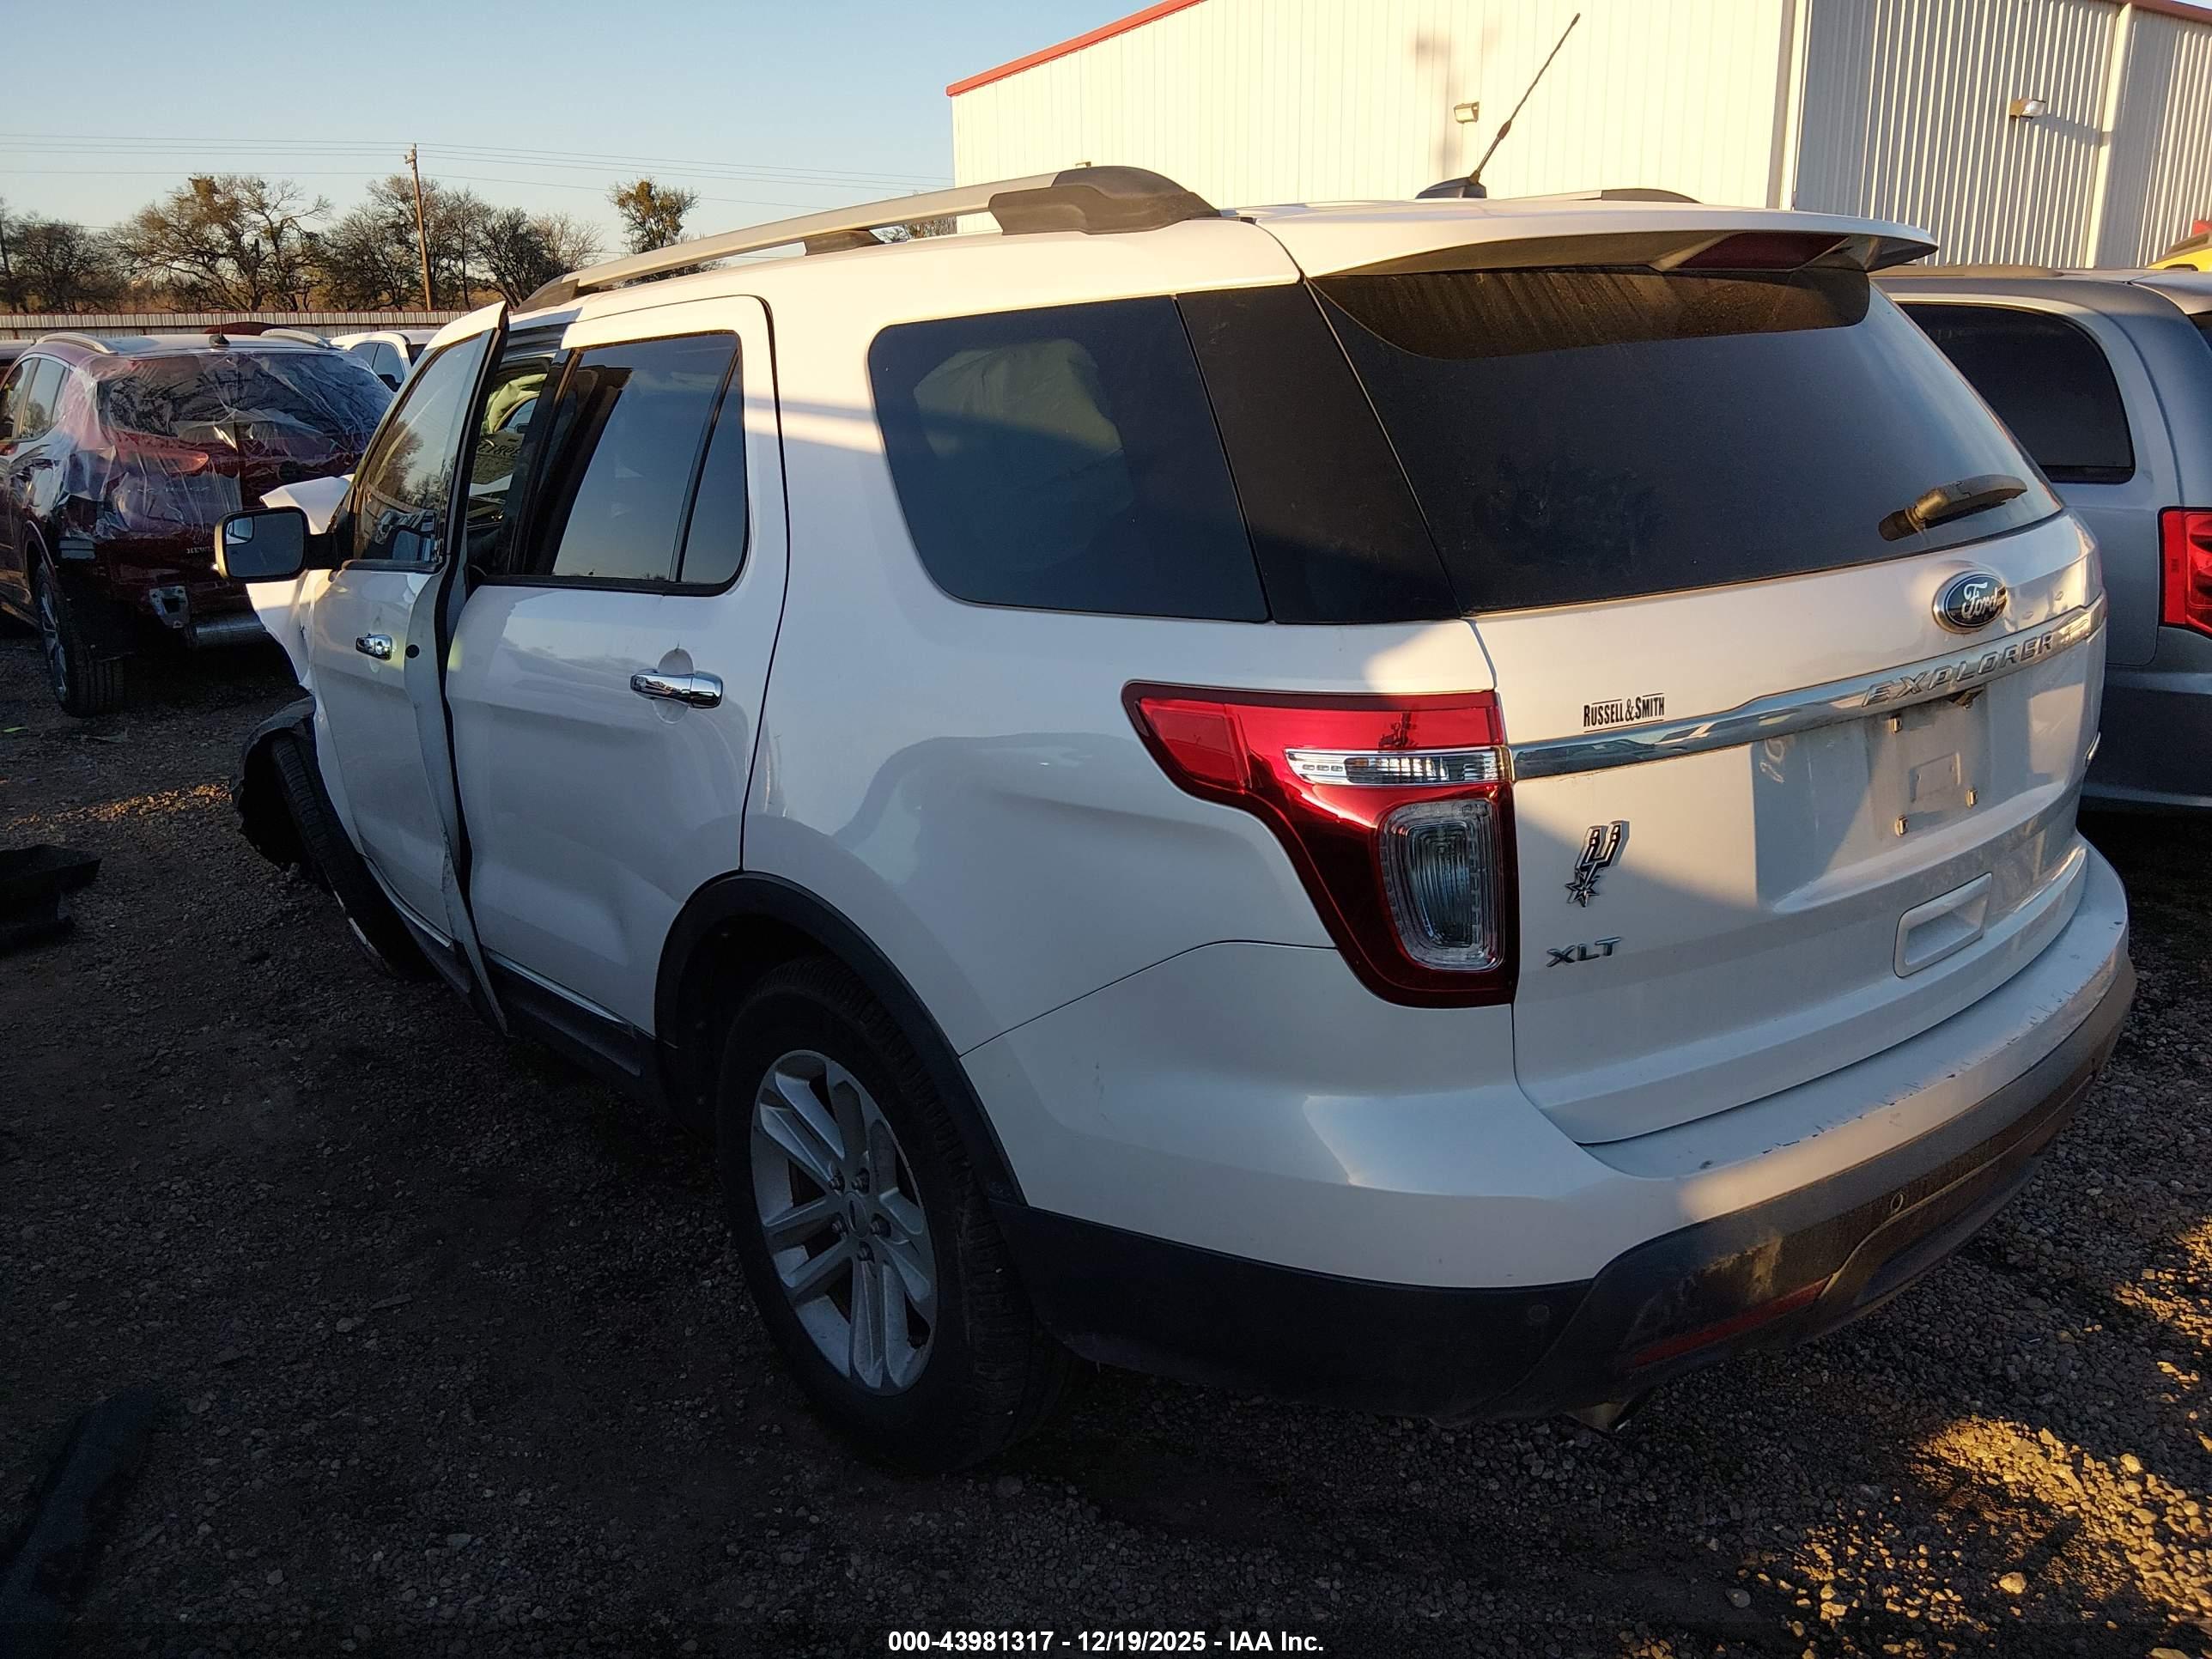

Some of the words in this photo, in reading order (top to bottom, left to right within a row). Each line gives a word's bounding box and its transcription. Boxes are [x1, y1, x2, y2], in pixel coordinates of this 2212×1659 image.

[1961, 581, 2001, 620] Ford
[1861, 630, 2054, 708] EXPLORER
[1546, 936, 1622, 968] XLT
